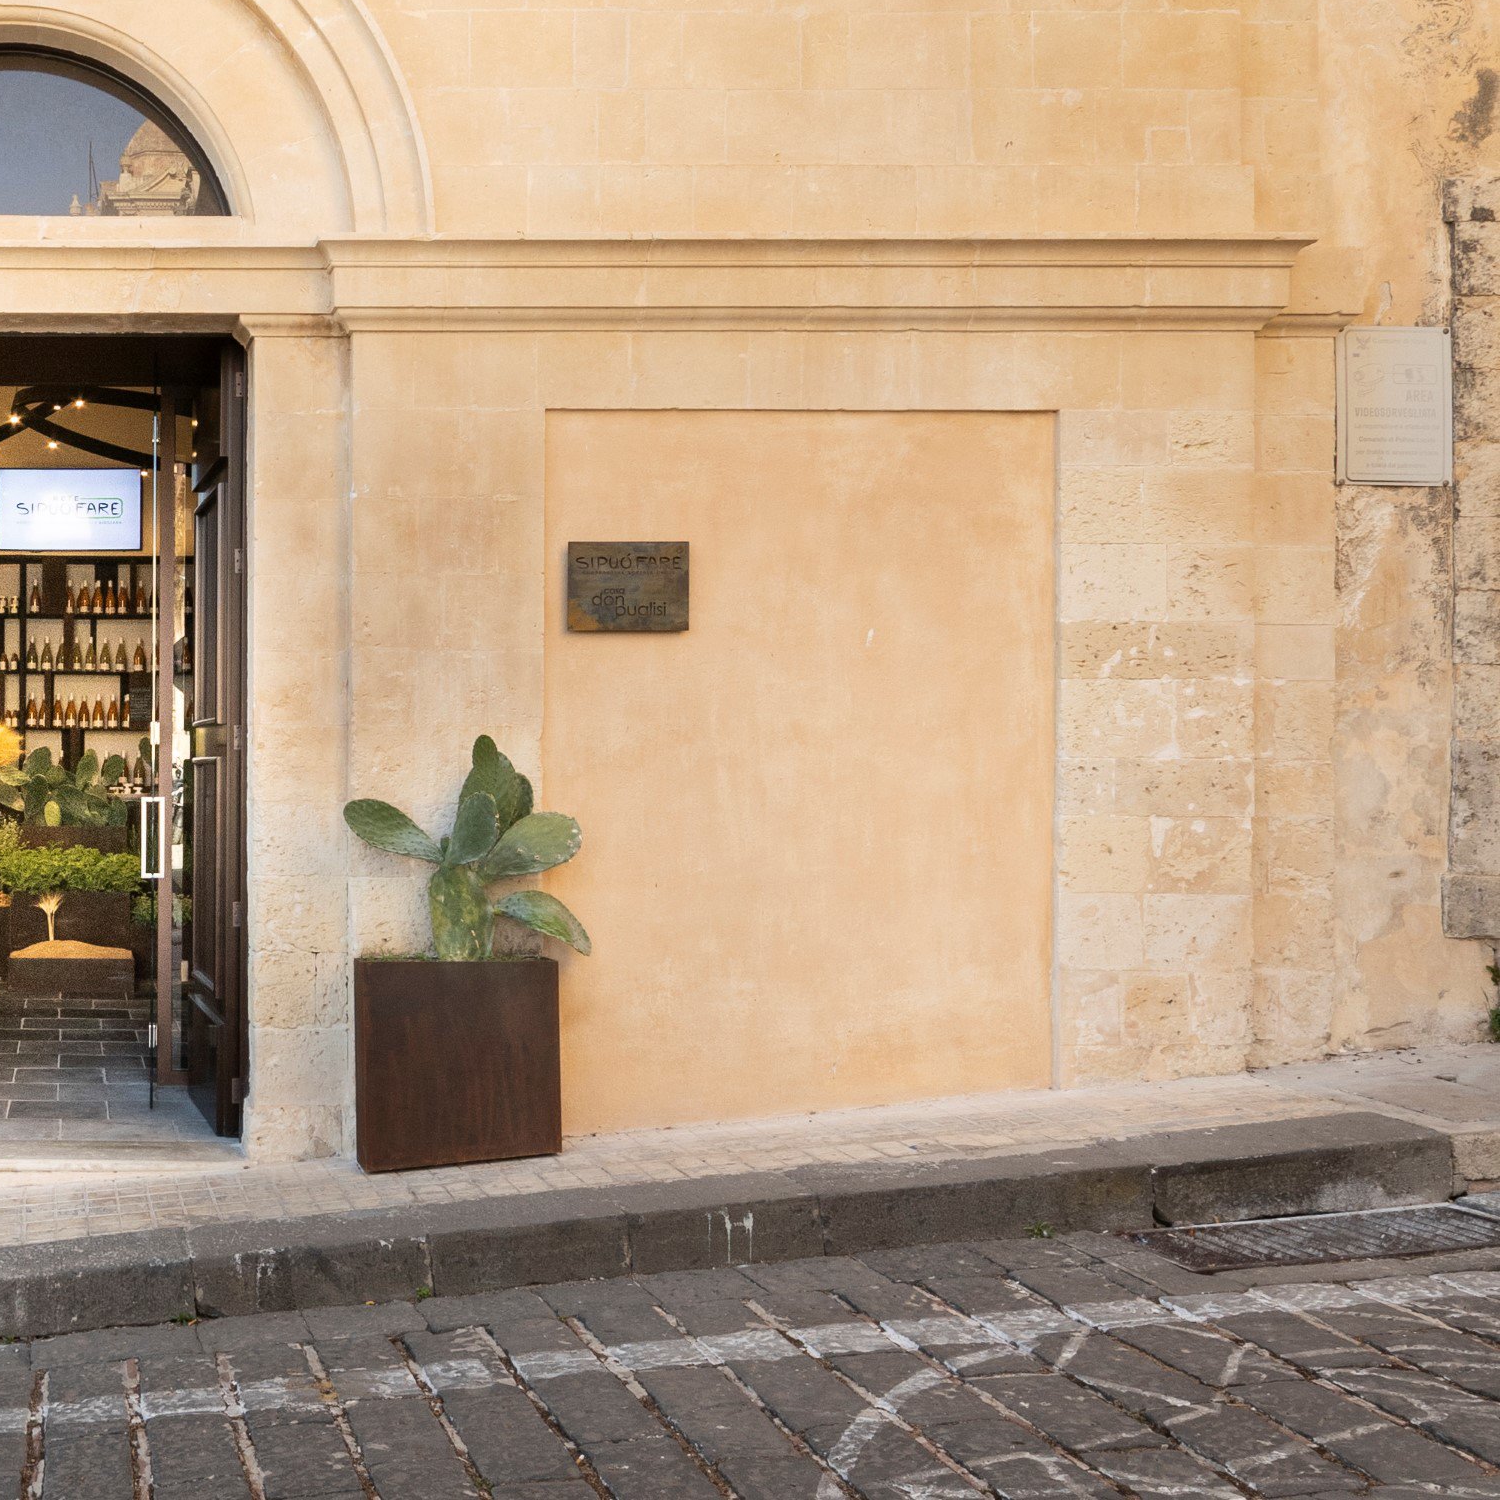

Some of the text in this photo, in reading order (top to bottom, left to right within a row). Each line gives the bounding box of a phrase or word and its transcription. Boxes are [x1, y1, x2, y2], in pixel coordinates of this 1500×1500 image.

[1406, 390, 1434, 403] AREA
[75, 502, 120, 516] FARE
[636, 556, 682, 570] FARE
[591, 591, 625, 606] don
